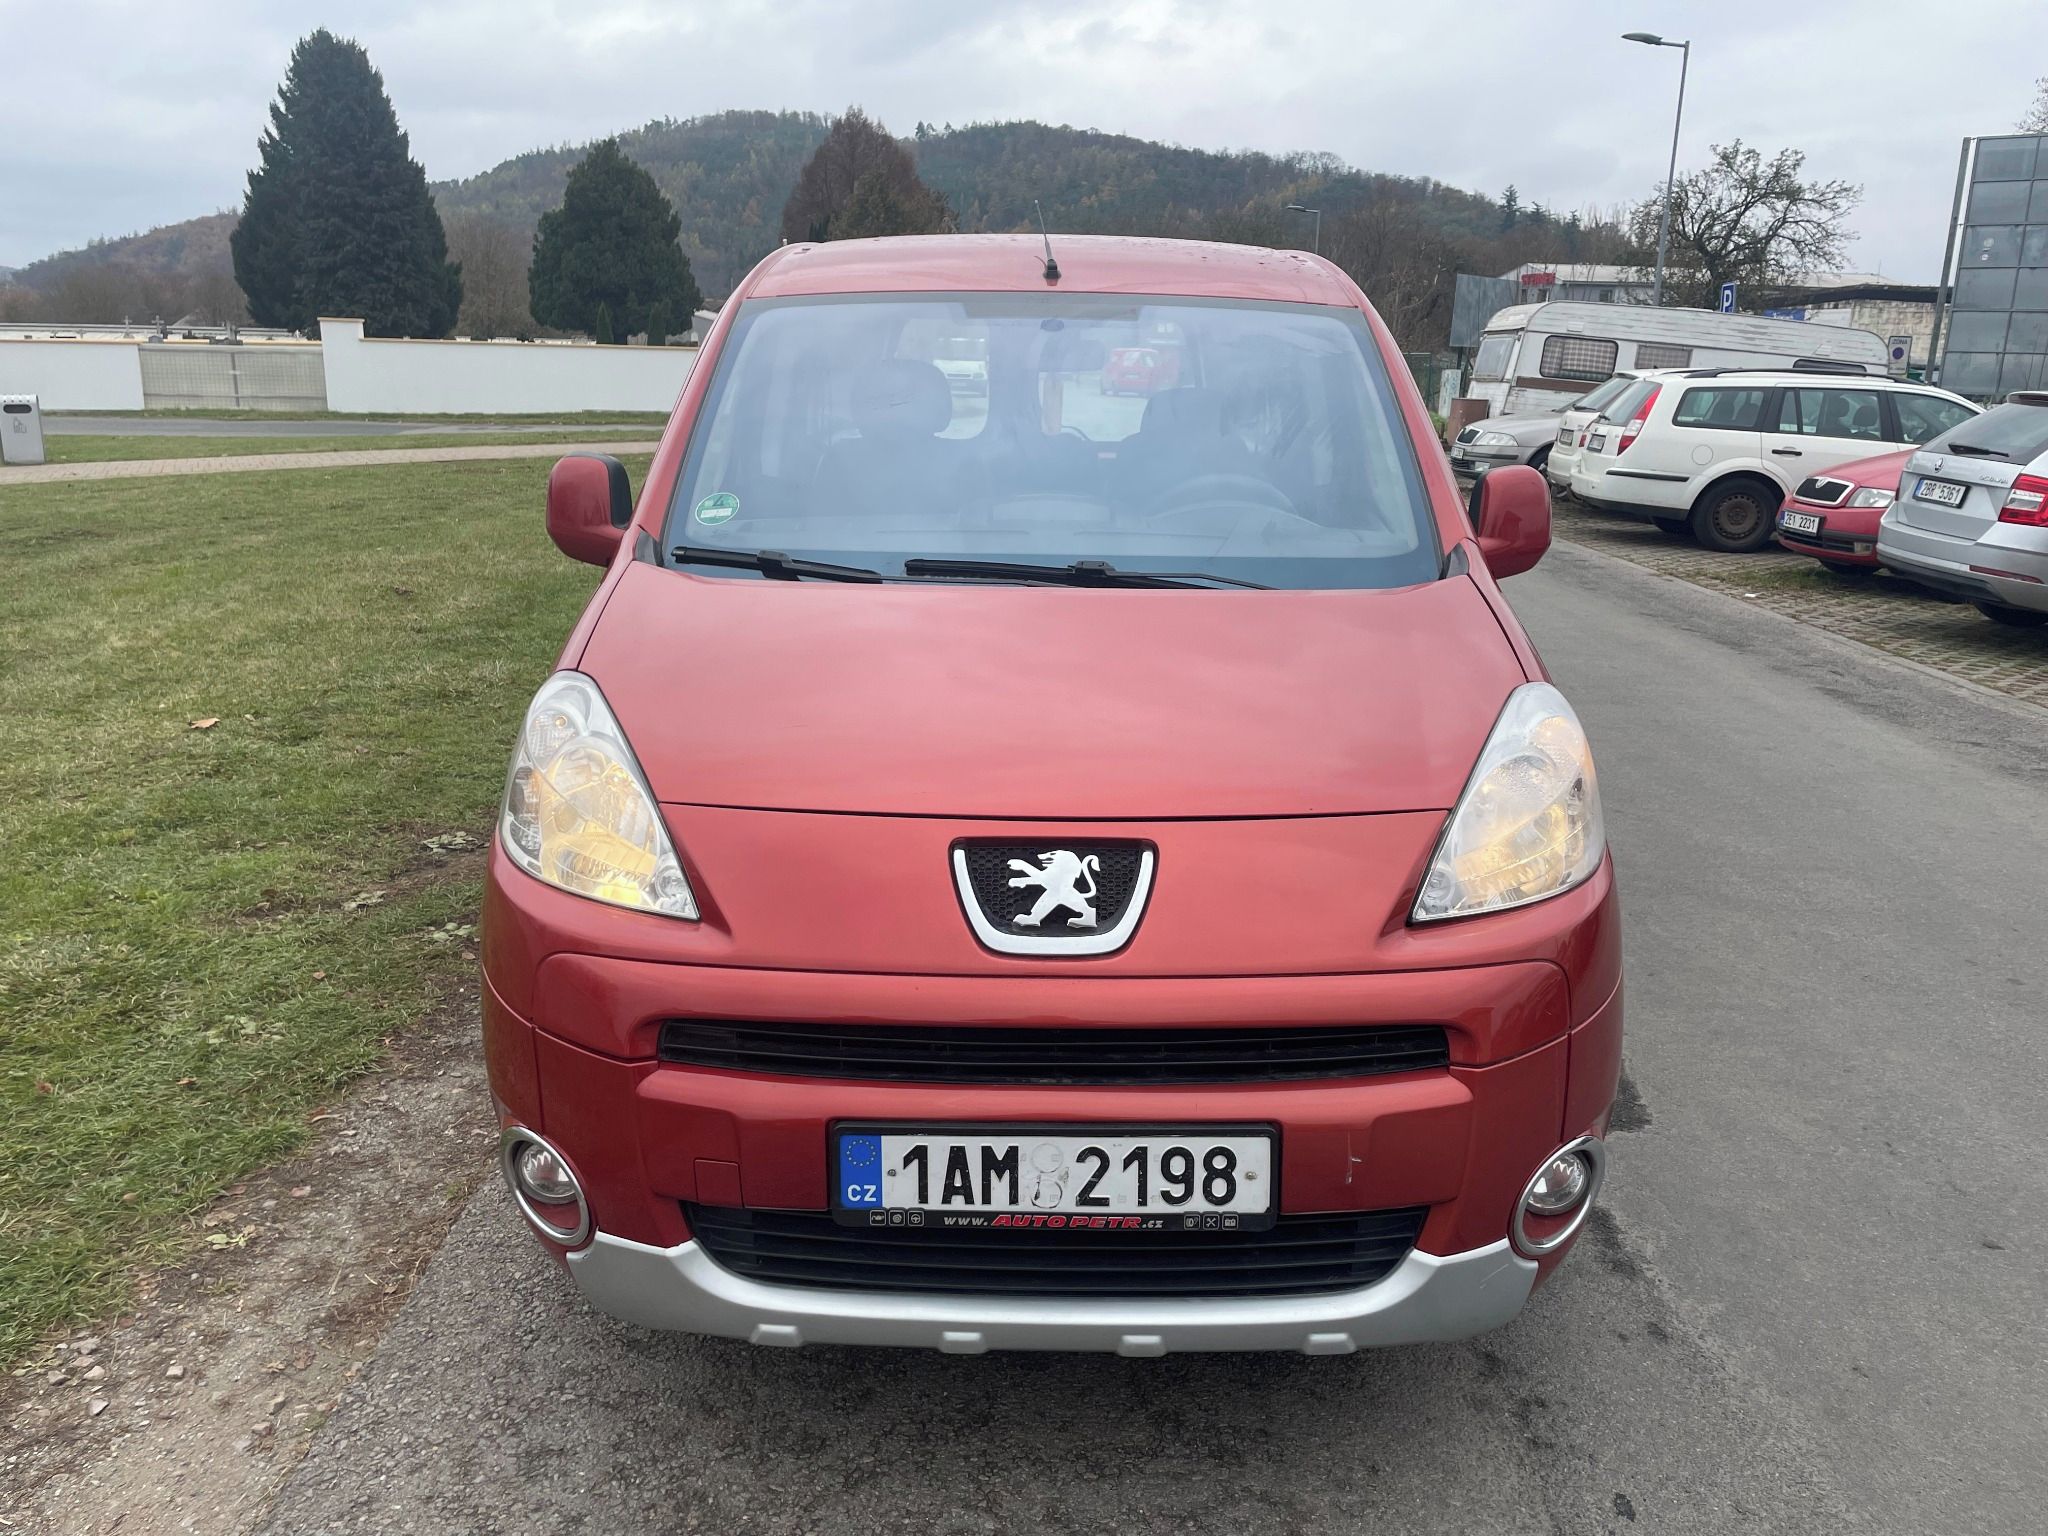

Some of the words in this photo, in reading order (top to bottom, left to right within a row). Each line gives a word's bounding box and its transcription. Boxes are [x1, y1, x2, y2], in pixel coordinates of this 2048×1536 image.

[1723, 289, 1732, 313] P
[1921, 481, 1937, 497] 2BR
[1938, 485, 1961, 502] 5361
[1799, 516, 1816, 530] 2231
[902, 1143, 1020, 1205] 1AM
[1074, 1145, 1238, 1208] 2198
[847, 1184, 877, 1202] CZ
